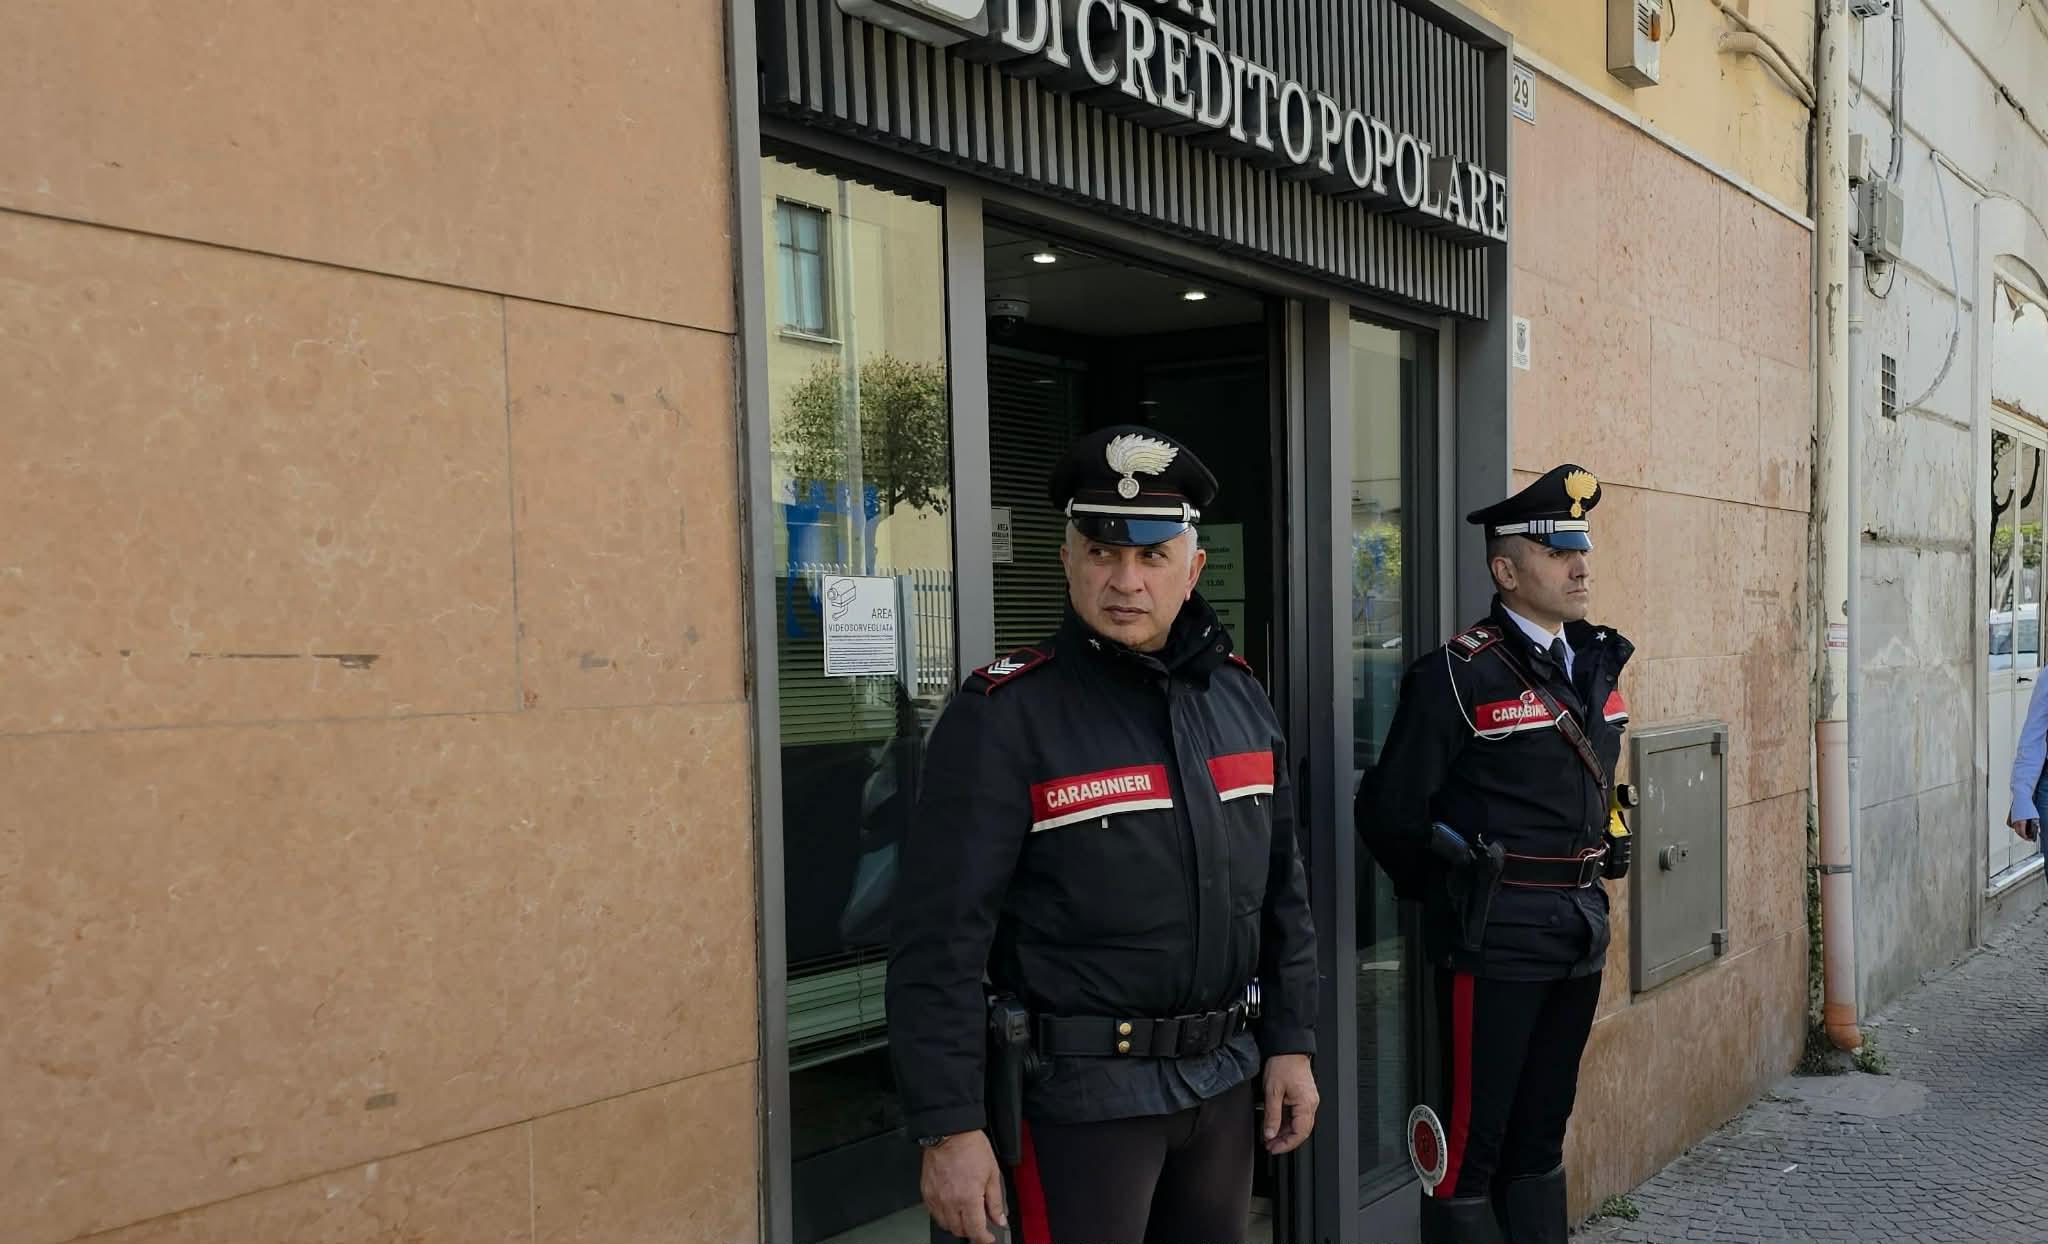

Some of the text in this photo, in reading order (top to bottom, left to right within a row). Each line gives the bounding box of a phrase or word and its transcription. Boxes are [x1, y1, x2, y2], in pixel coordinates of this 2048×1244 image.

[1513, 74, 1529, 108] 29
[1077, 0, 1313, 164] CREDITO
[1316, 91, 1509, 242] POPOLARE
[872, 608, 893, 619] AREA
[1492, 703, 1549, 722] CARABINE
[1046, 774, 1152, 809] CARABINIERI
